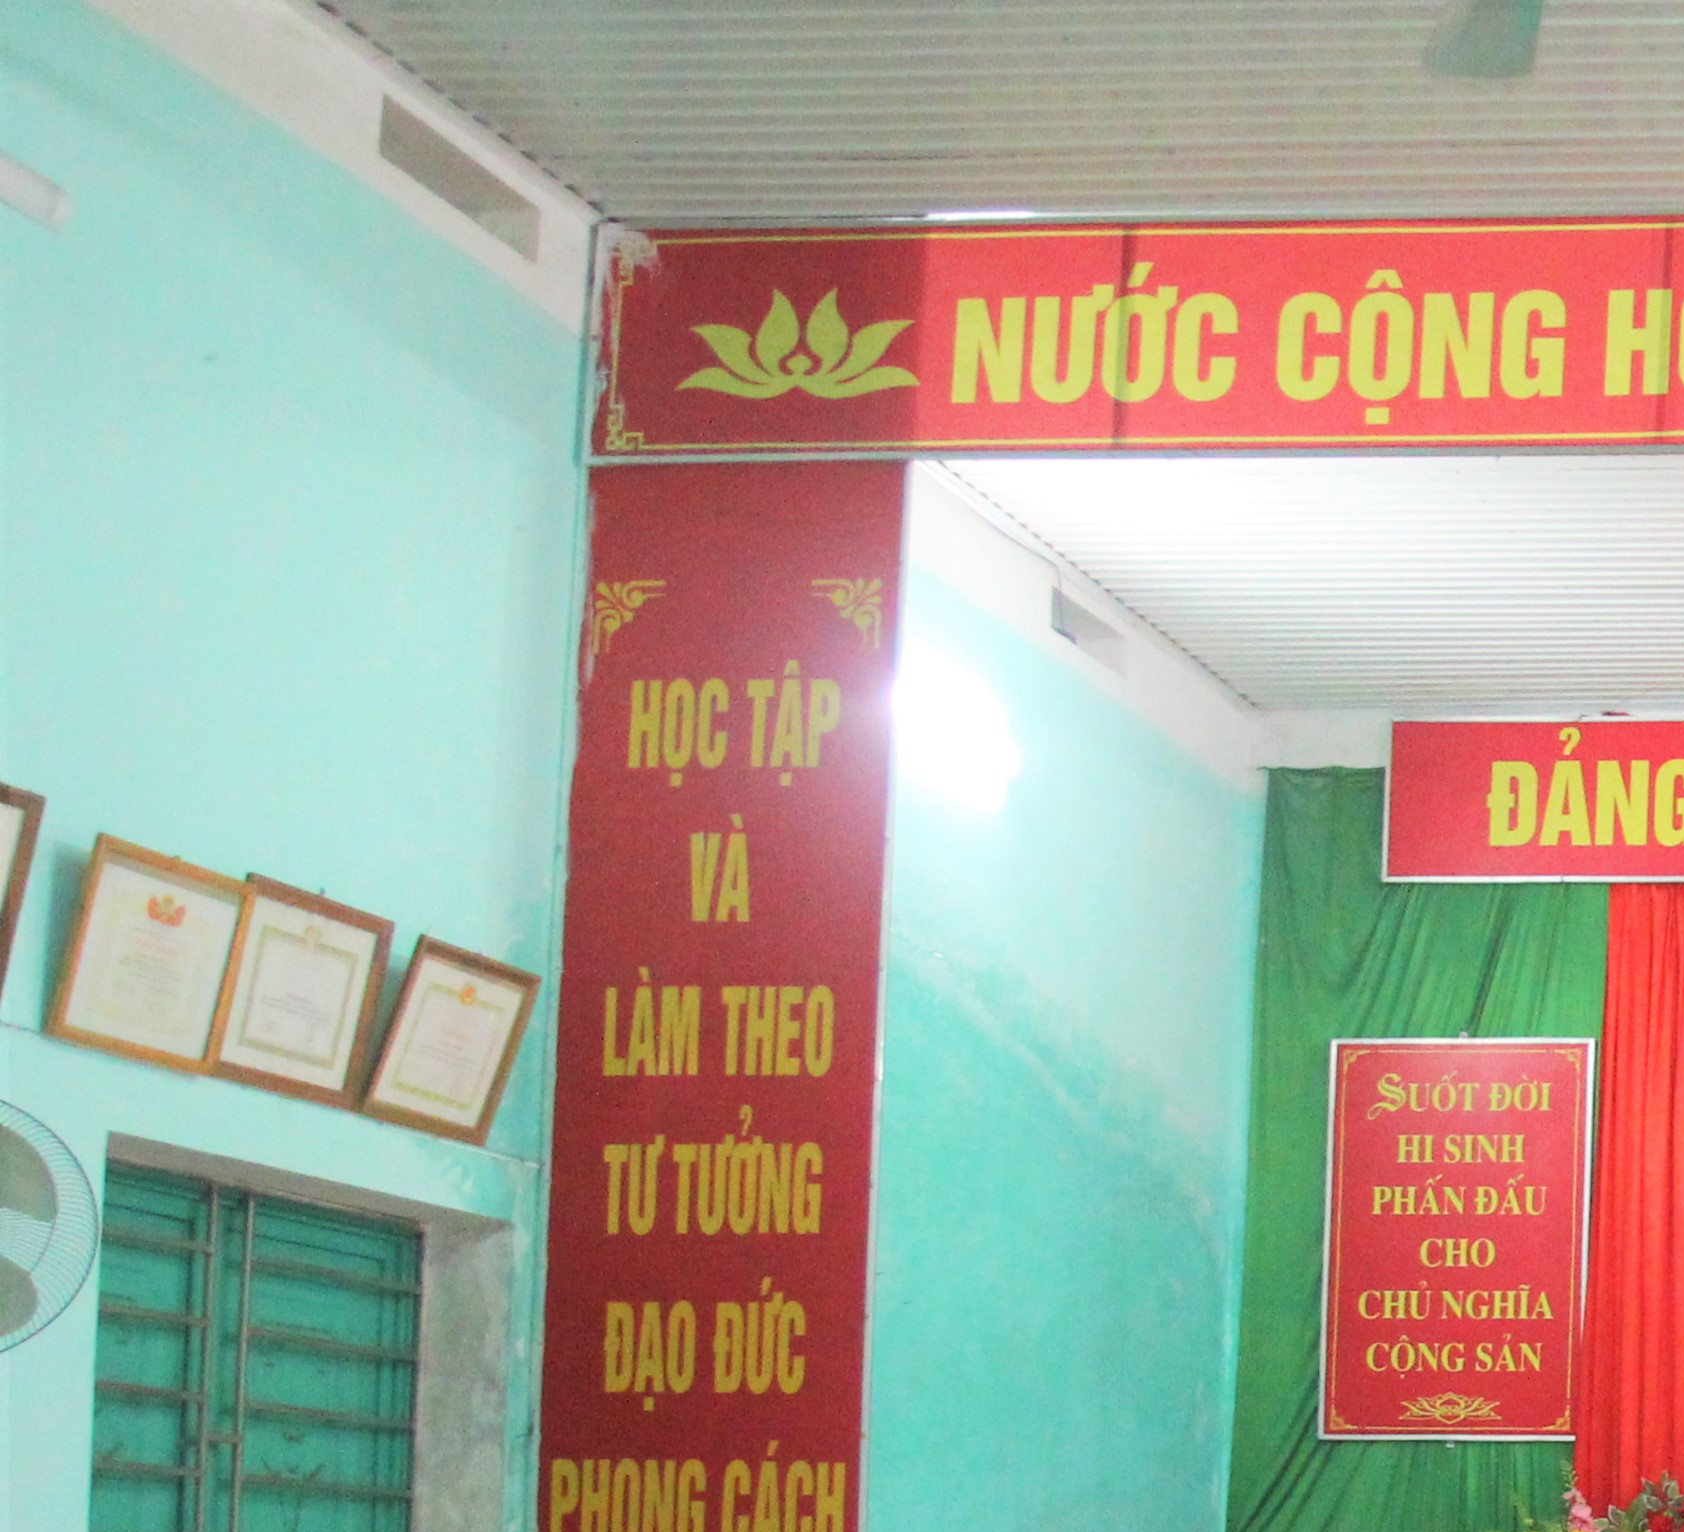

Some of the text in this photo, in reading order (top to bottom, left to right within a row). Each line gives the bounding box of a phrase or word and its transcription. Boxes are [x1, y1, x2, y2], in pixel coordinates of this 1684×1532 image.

[951, 261, 1238, 404] NƯỚC
[1277, 268, 1566, 425] CỘNG
[627, 659, 842, 787] HỌC TẬP
[689, 813, 751, 923] VÀ
[602, 966, 701, 1077] LÀM
[721, 984, 836, 1078] THEO
[1367, 1070, 1553, 1120] SUỐT ĐỜI
[603, 1105, 824, 1236] TƯ TƯỞNG
[1396, 1134, 1526, 1164] HI SINH
[1371, 1174, 1549, 1216] PHẤN ĐẤU
[1418, 1237, 1497, 1268] CHO
[1357, 1280, 1555, 1321] CHỦ NGHĨA
[603, 1276, 807, 1411] ĐẠO ĐỨC
[1365, 1333, 1544, 1380] CỘNG SẢN
